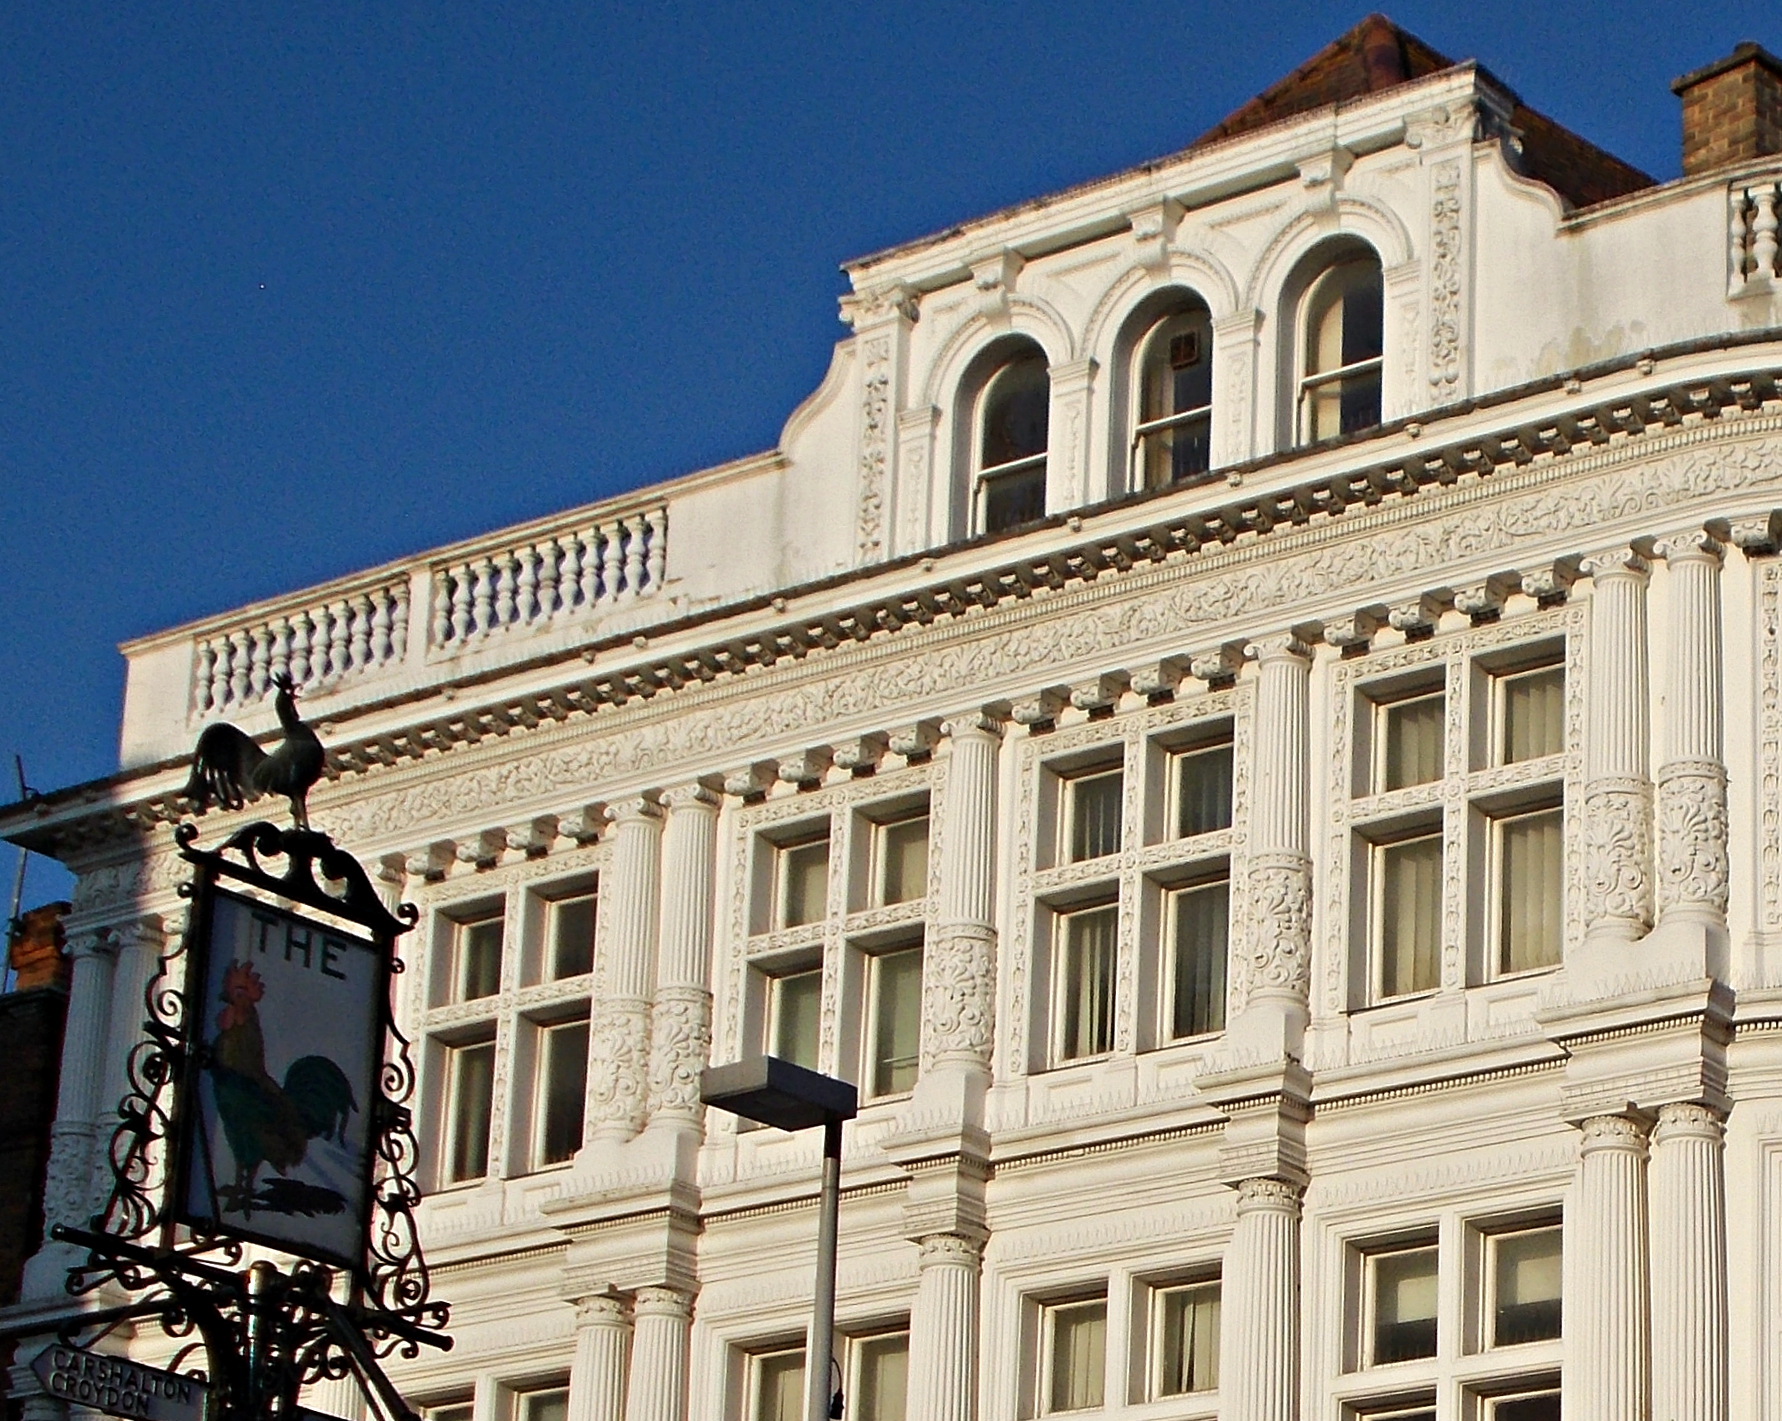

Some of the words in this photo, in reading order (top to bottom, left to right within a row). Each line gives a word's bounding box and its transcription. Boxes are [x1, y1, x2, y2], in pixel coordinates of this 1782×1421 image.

[251, 909, 347, 980] THE
[51, 1372, 150, 1416] CROYDON
[52, 1350, 191, 1404] CARSHALTON
